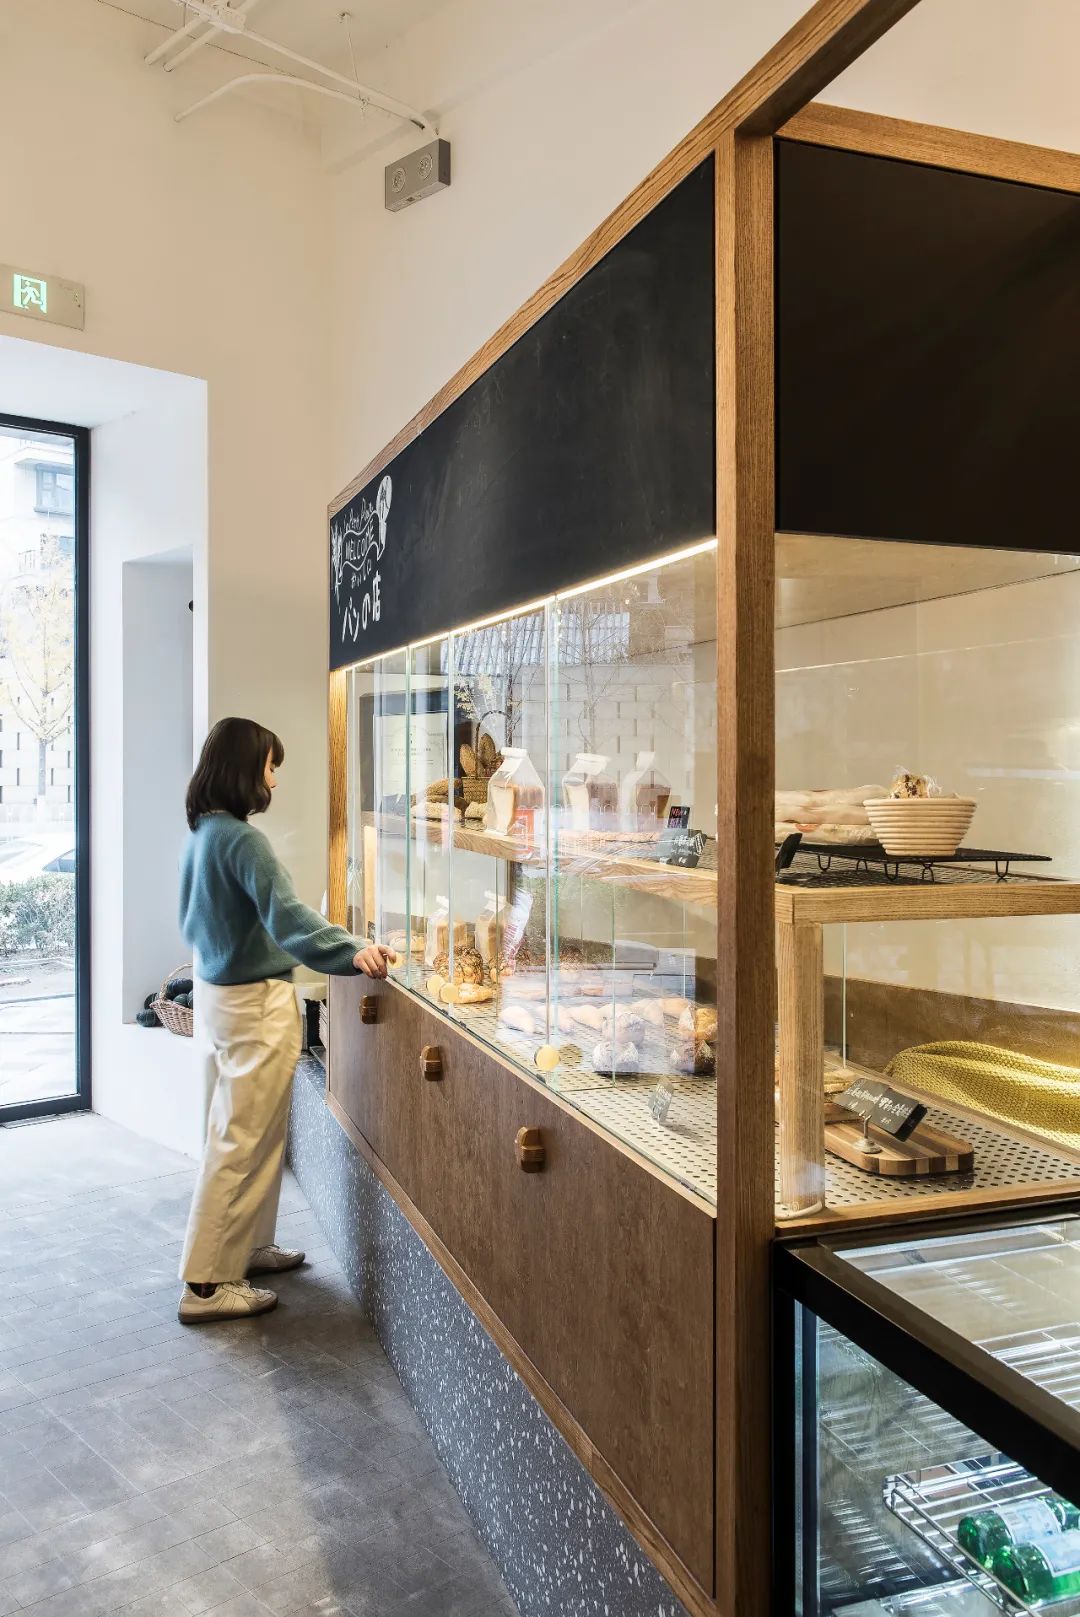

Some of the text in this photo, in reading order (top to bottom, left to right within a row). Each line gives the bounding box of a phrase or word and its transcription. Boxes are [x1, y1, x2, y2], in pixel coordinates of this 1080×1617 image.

[345, 518, 375, 560] WELCOME
[341, 569, 382, 643] パンの店
